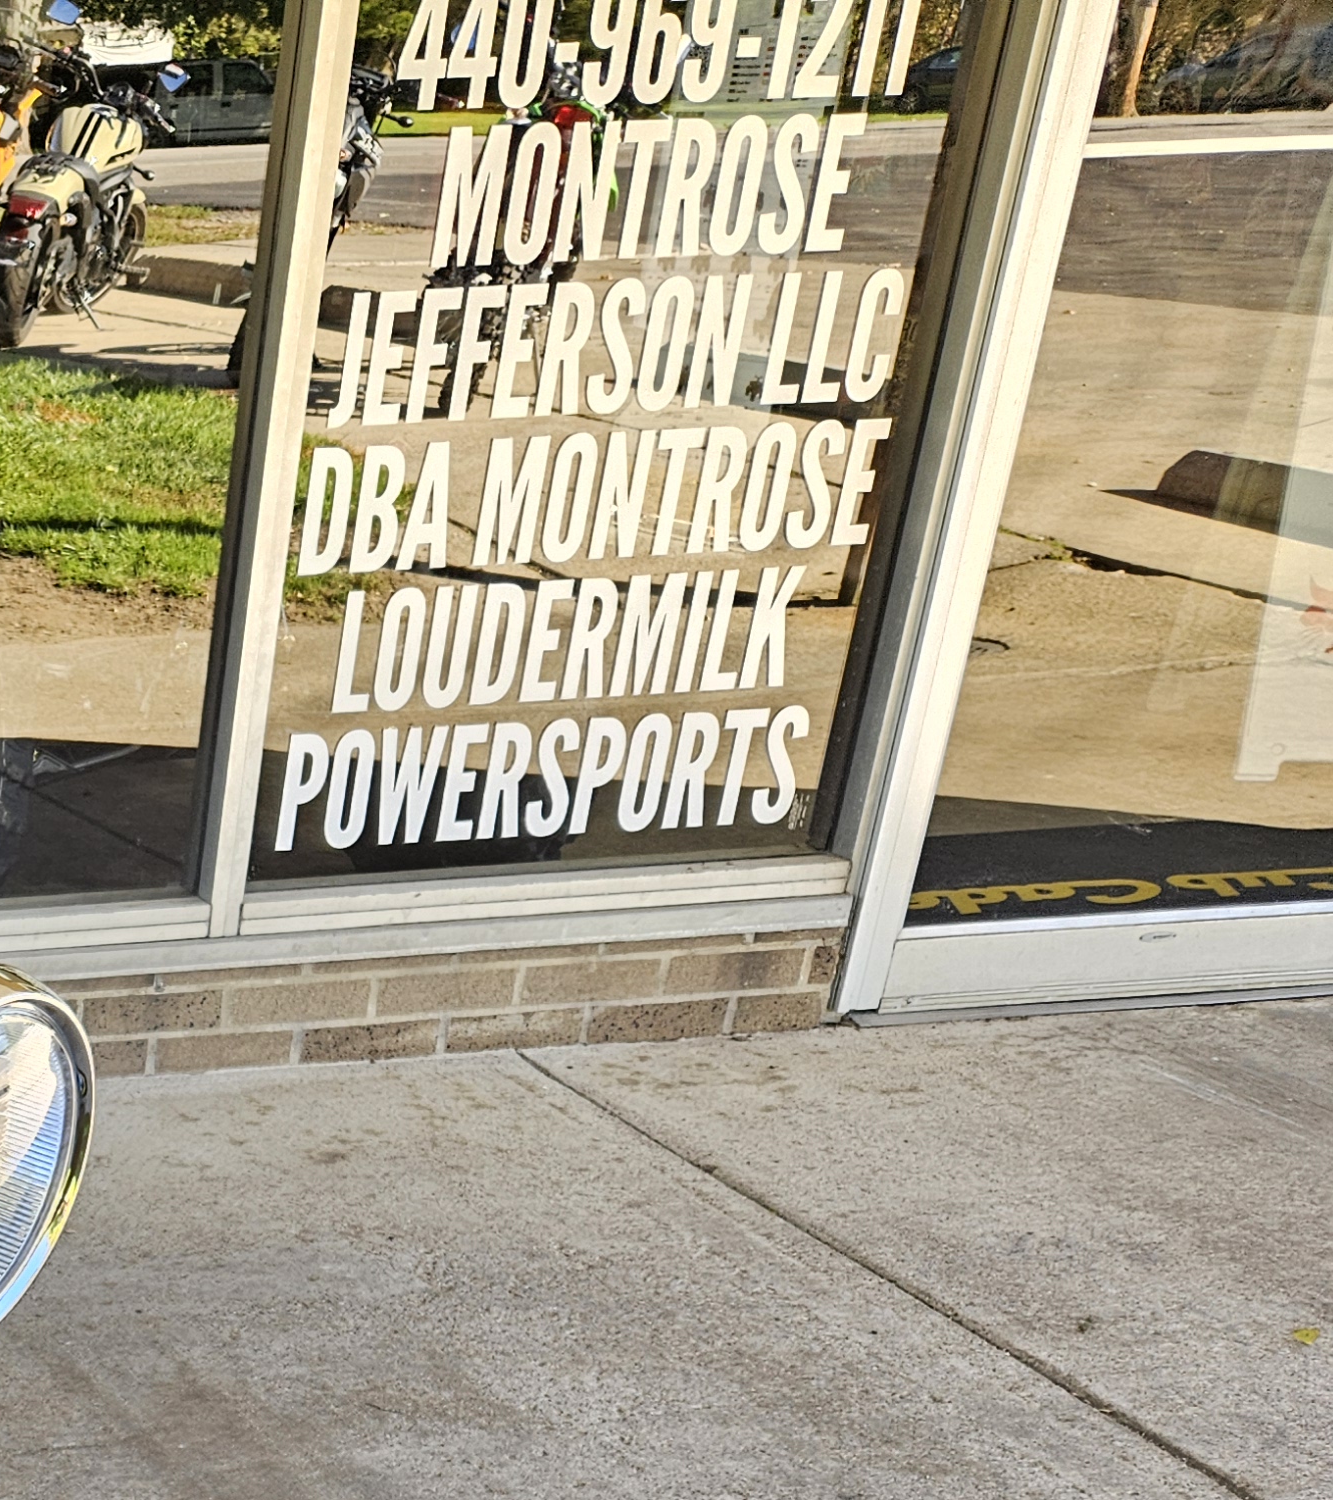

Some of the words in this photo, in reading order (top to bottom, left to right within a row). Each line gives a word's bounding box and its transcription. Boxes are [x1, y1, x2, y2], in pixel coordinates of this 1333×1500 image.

[430, 112, 867, 269] MONTROSE
[327, 273, 753, 429] JEFFERSON
[759, 267, 906, 407] LLC
[297, 441, 452, 577] DBA
[473, 417, 892, 567] MONTROSE
[332, 565, 807, 714] LOUDERMILK
[275, 705, 810, 853] POWERSPORTS
